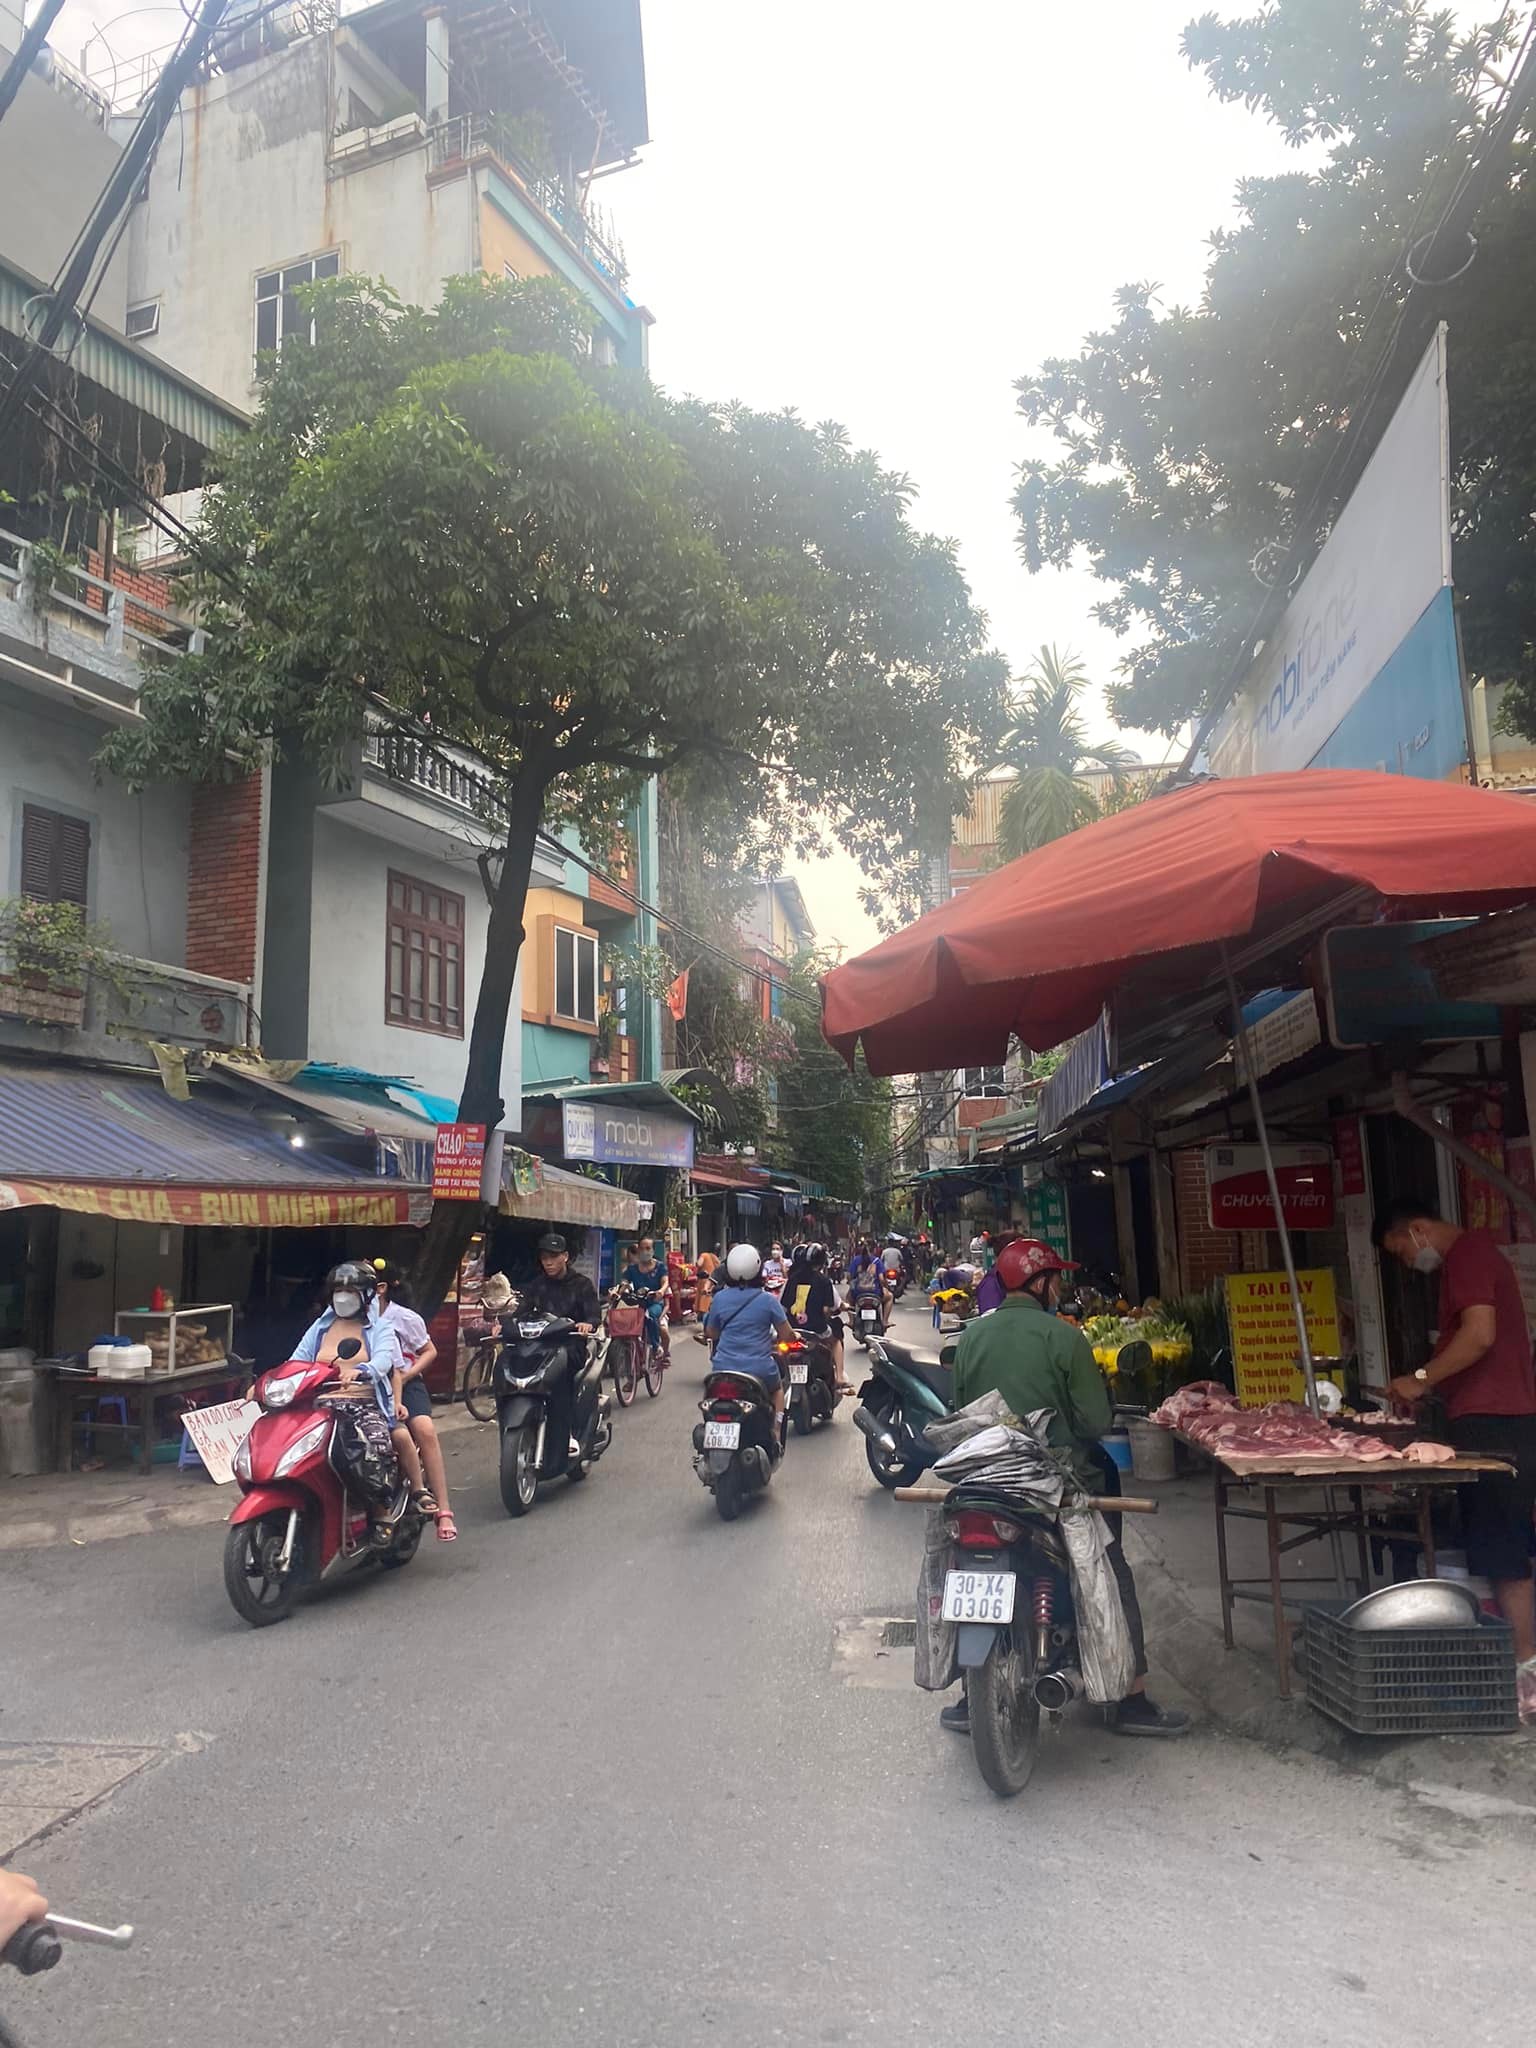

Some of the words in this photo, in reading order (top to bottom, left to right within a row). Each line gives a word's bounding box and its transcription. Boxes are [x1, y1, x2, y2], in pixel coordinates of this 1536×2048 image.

[1247, 1281, 1274, 1298] TẠI
[955, 1575, 1004, 1596] 30-X4
[953, 1597, 1003, 1619] 0306
